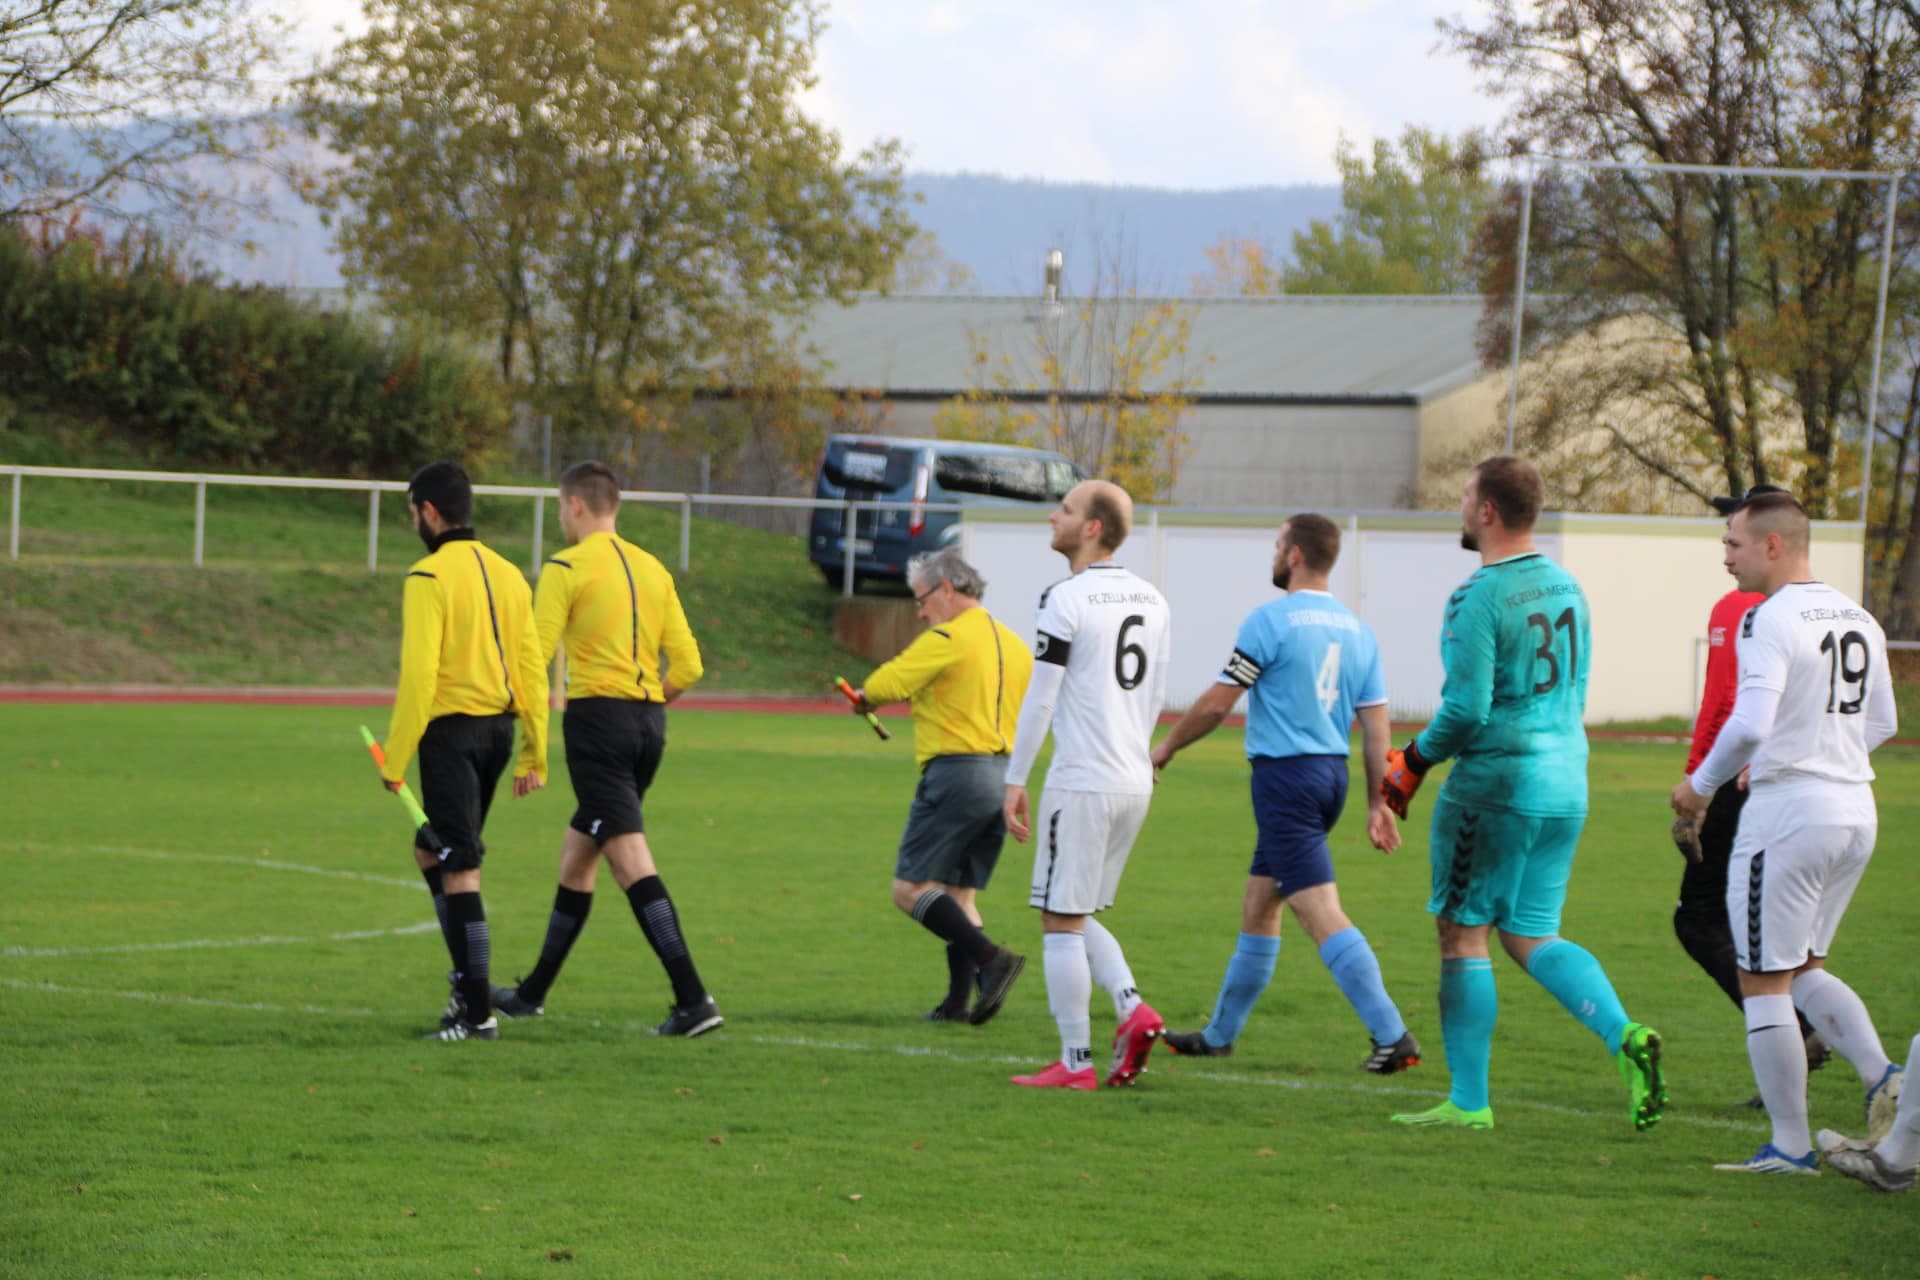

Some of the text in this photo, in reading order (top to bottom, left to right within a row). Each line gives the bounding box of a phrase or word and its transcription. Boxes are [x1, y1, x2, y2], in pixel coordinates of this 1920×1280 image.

[1115, 614, 1147, 691] 6
[1316, 642, 1342, 712] 4
[1527, 607, 1577, 694] 31
[1820, 630, 1870, 714] 19
